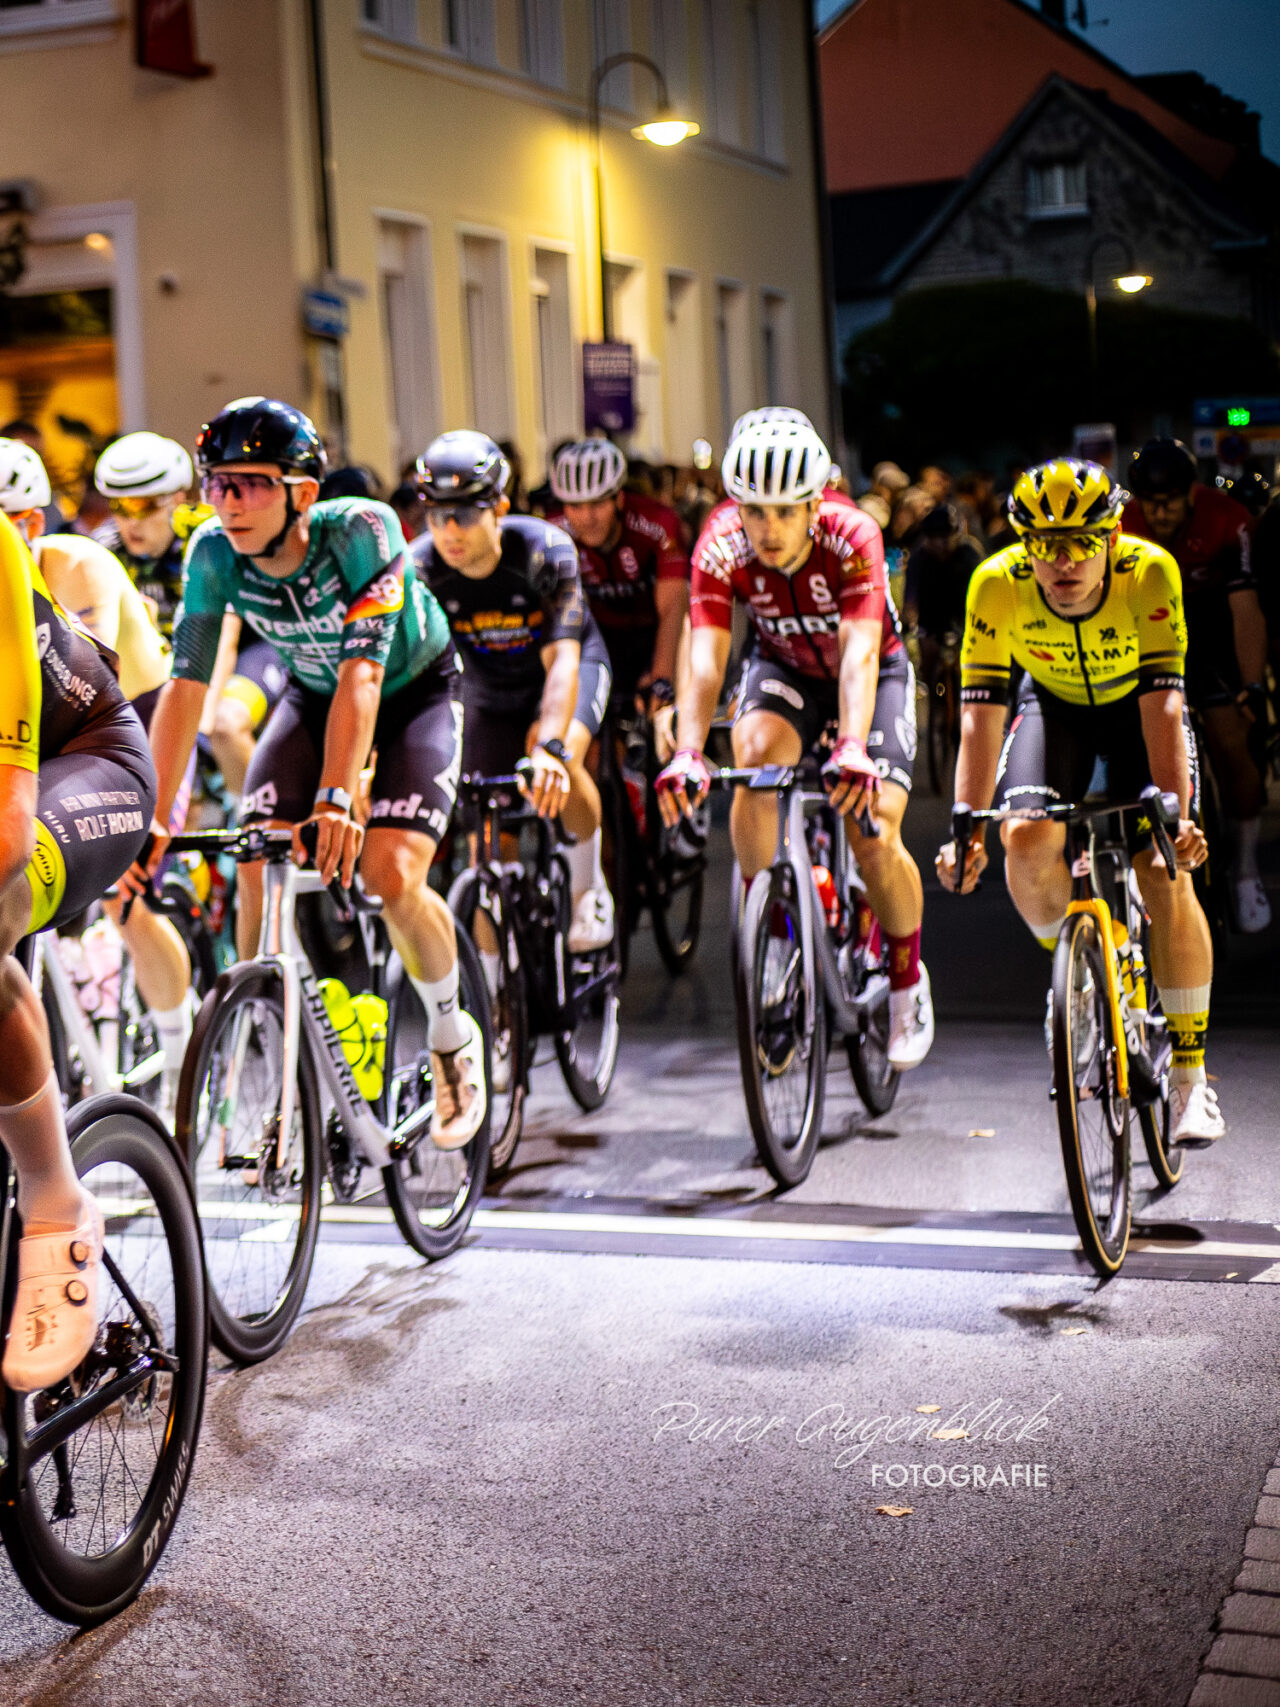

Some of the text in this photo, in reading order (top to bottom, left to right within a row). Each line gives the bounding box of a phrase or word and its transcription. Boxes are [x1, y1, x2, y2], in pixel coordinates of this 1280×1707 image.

[73, 810, 144, 842] ROLF HORN
[299, 974, 364, 1118] LAPIERRE
[142, 1441, 190, 1568] DT SWISS
